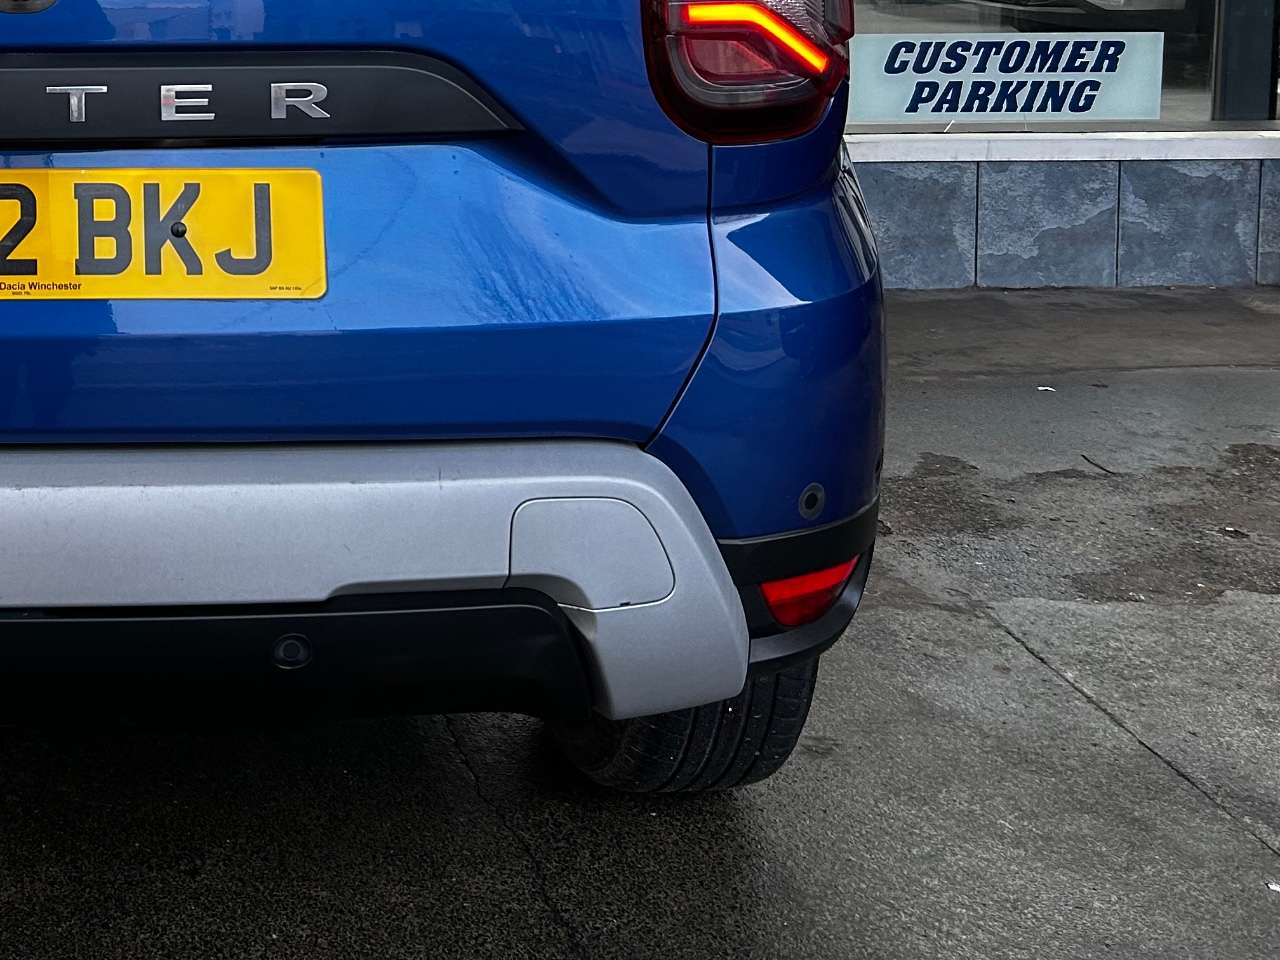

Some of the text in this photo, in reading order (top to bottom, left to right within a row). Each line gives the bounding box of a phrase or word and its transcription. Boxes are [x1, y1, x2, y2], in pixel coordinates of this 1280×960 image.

[883, 40, 1126, 74] CUSTOMER
[904, 79, 1102, 113] PARKING
[73, 182, 273, 276] BKJ
[0, 281, 26, 291] Dacia
[28, 281, 82, 291] Winchester
